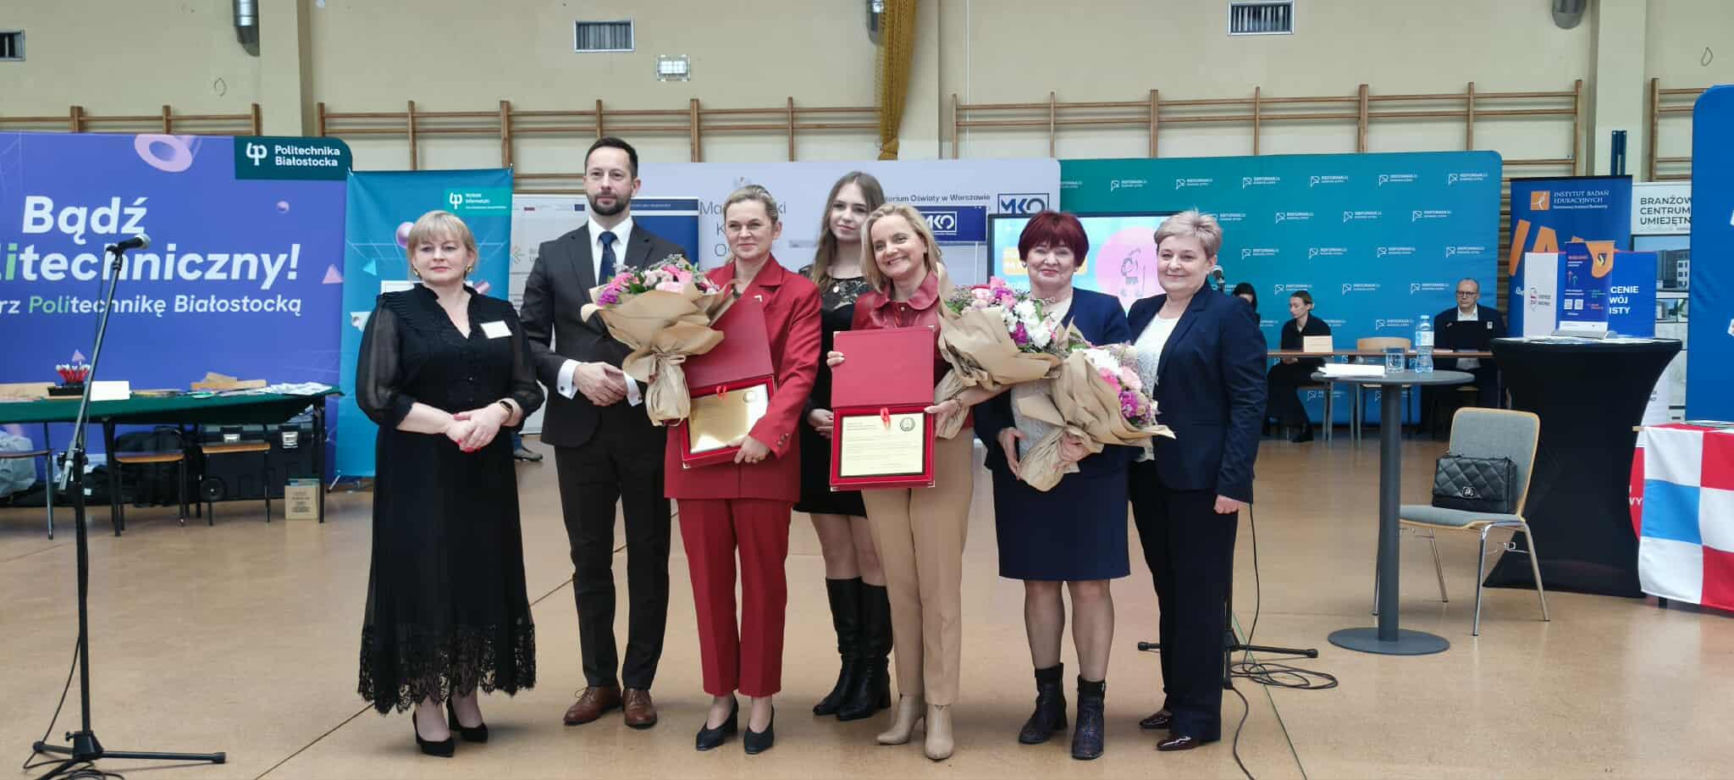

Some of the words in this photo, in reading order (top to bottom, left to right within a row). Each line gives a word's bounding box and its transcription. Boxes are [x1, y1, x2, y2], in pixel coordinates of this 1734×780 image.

[275, 145, 340, 155] Politechnika
[275, 156, 338, 166] Białostocka
[1640, 206, 1691, 215] CENTRUM
[22, 196, 148, 245] Bądź
[0, 243, 301, 290] itechniczny!
[174, 294, 302, 317] Białostocką
